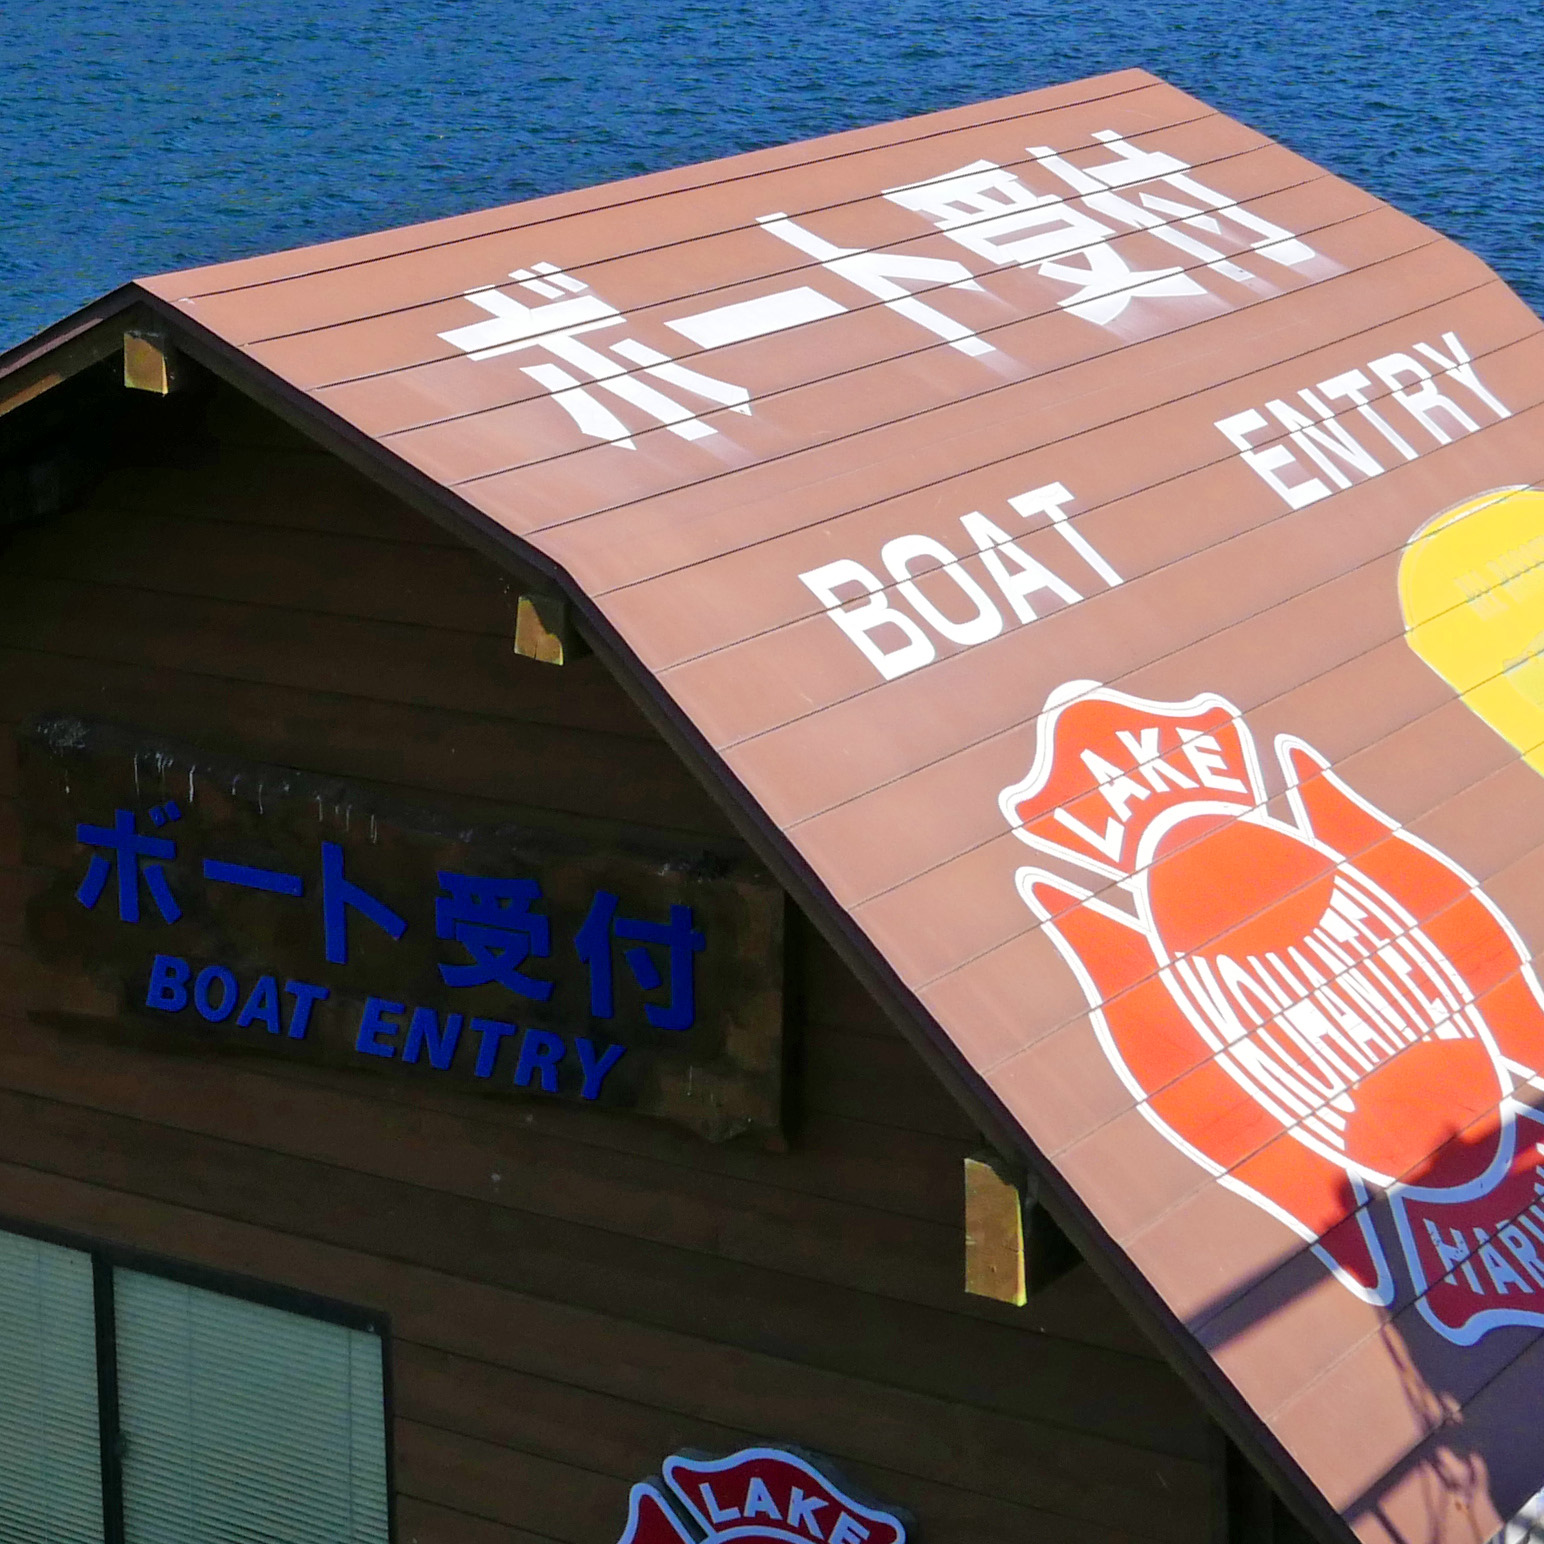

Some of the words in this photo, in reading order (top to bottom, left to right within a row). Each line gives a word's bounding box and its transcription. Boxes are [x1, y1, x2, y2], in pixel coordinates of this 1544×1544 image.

[437, 129, 1317, 451] ボート受付
[798, 481, 1124, 681] BOAT
[1213, 331, 1512, 510] ENTRY
[1054, 727, 1255, 864] LAKE
[75, 800, 707, 1031] ボート受付
[146, 954, 328, 1040] BOAT
[355, 996, 627, 1101] ENTRY
[698, 1476, 870, 1544] LAKE
